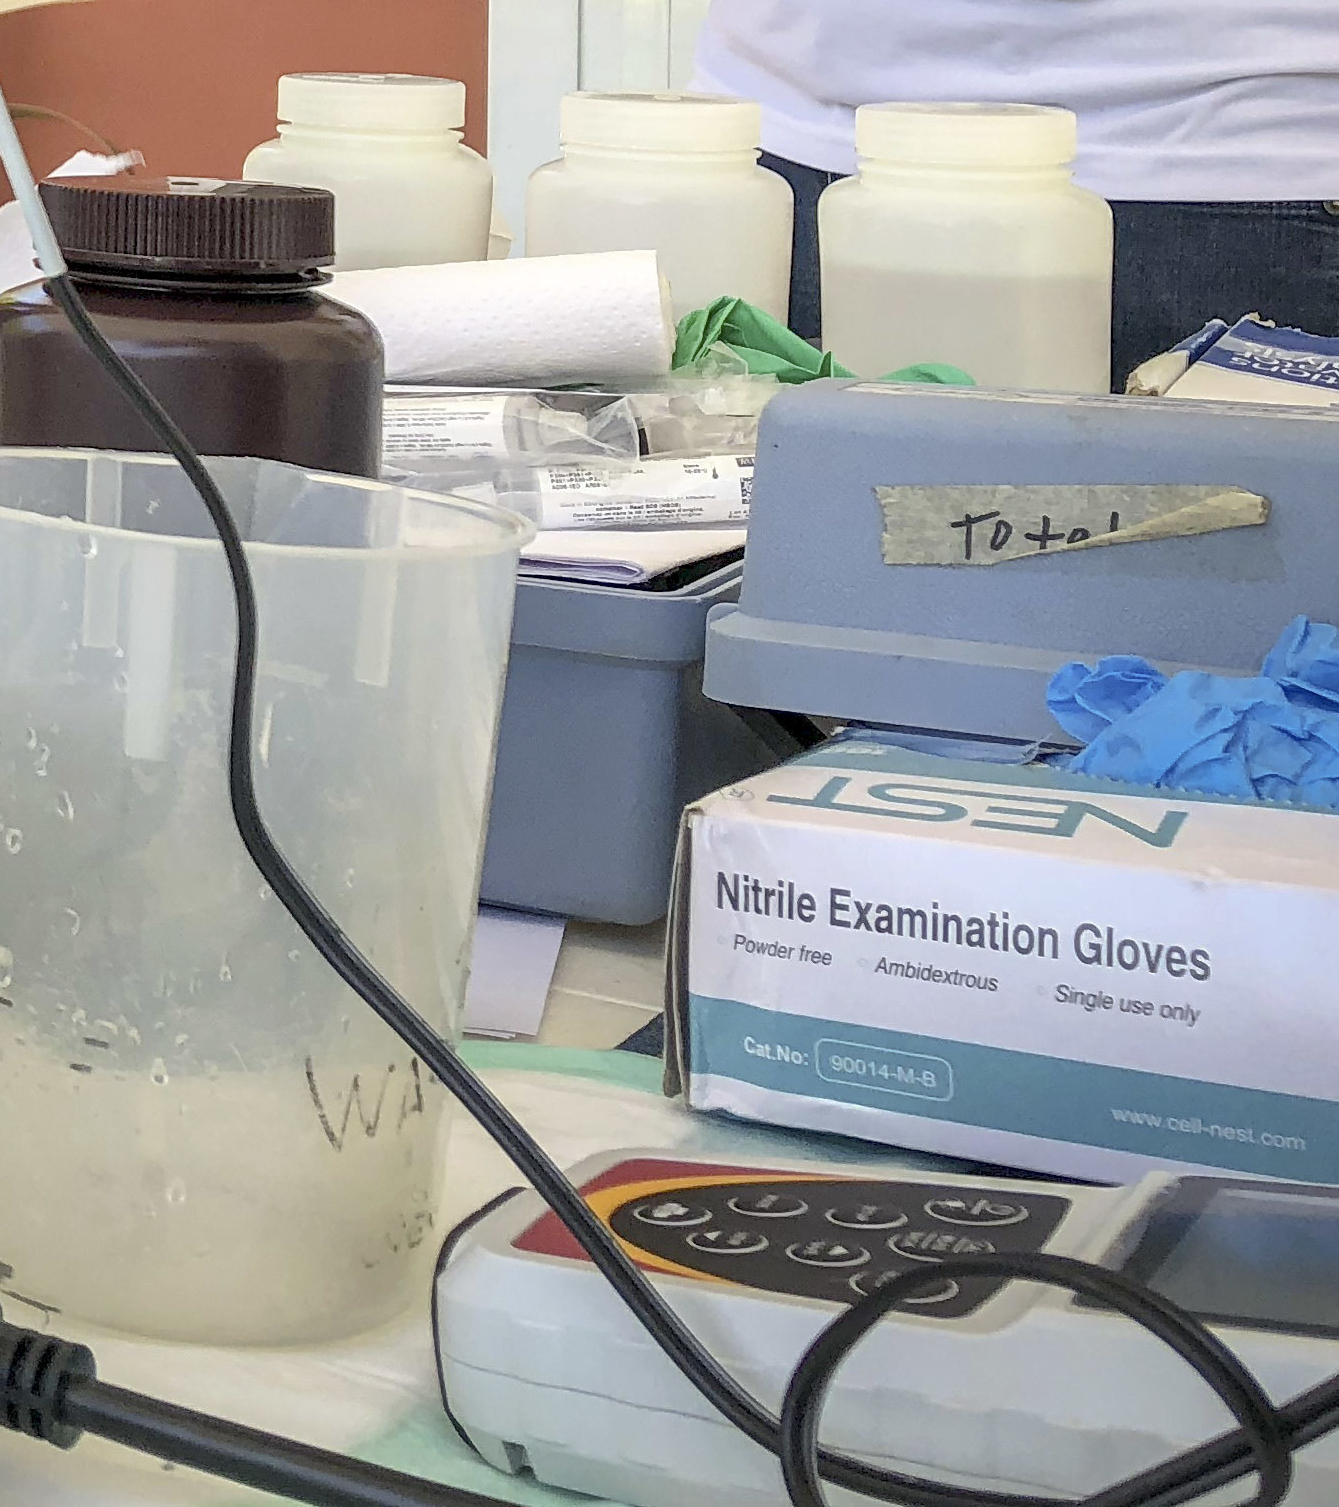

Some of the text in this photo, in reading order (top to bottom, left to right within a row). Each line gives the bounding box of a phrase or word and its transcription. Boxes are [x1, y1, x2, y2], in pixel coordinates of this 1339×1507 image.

[767, 776, 1188, 848] NEST
[716, 871, 1211, 981] Nitrile Examination Gloves
[733, 933, 833, 966] Powder free
[874, 956, 999, 992] Ambidextrous
[1055, 983, 1201, 1028] Single use only
[743, 1036, 938, 1088] Cat.No: 90014-M-B
[1110, 1109, 1306, 1151] www.cell-nest.com
